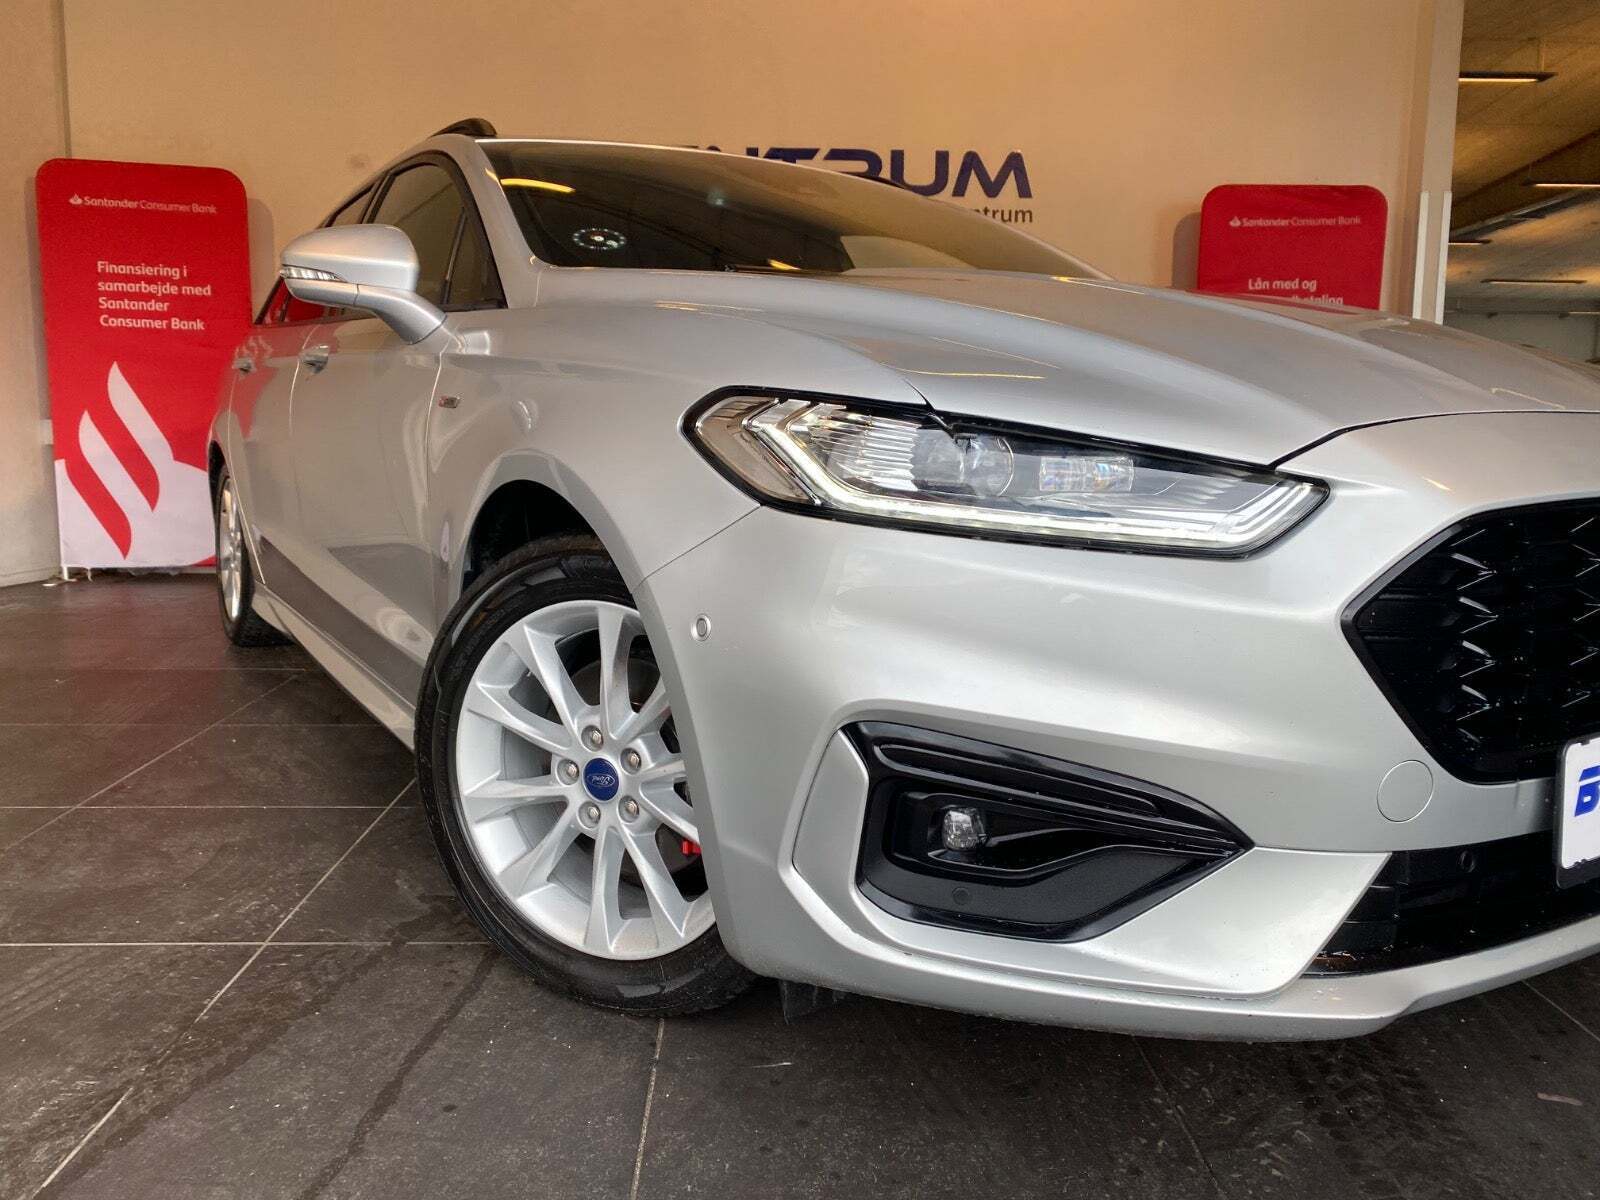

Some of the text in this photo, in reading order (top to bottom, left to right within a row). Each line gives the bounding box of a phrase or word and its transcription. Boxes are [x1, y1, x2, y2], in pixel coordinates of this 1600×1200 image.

[84, 196, 217, 213] Santander Consumer Bank
[973, 206, 1033, 223] trum
[1242, 215, 1361, 227] Santander Consumer Bank
[96, 260, 188, 280] Finansiering i
[97, 280, 212, 297] samarbejde med
[1248, 277, 1317, 292] Lån med og
[98, 296, 170, 311] Santander
[99, 314, 206, 331] Consumer Bank
